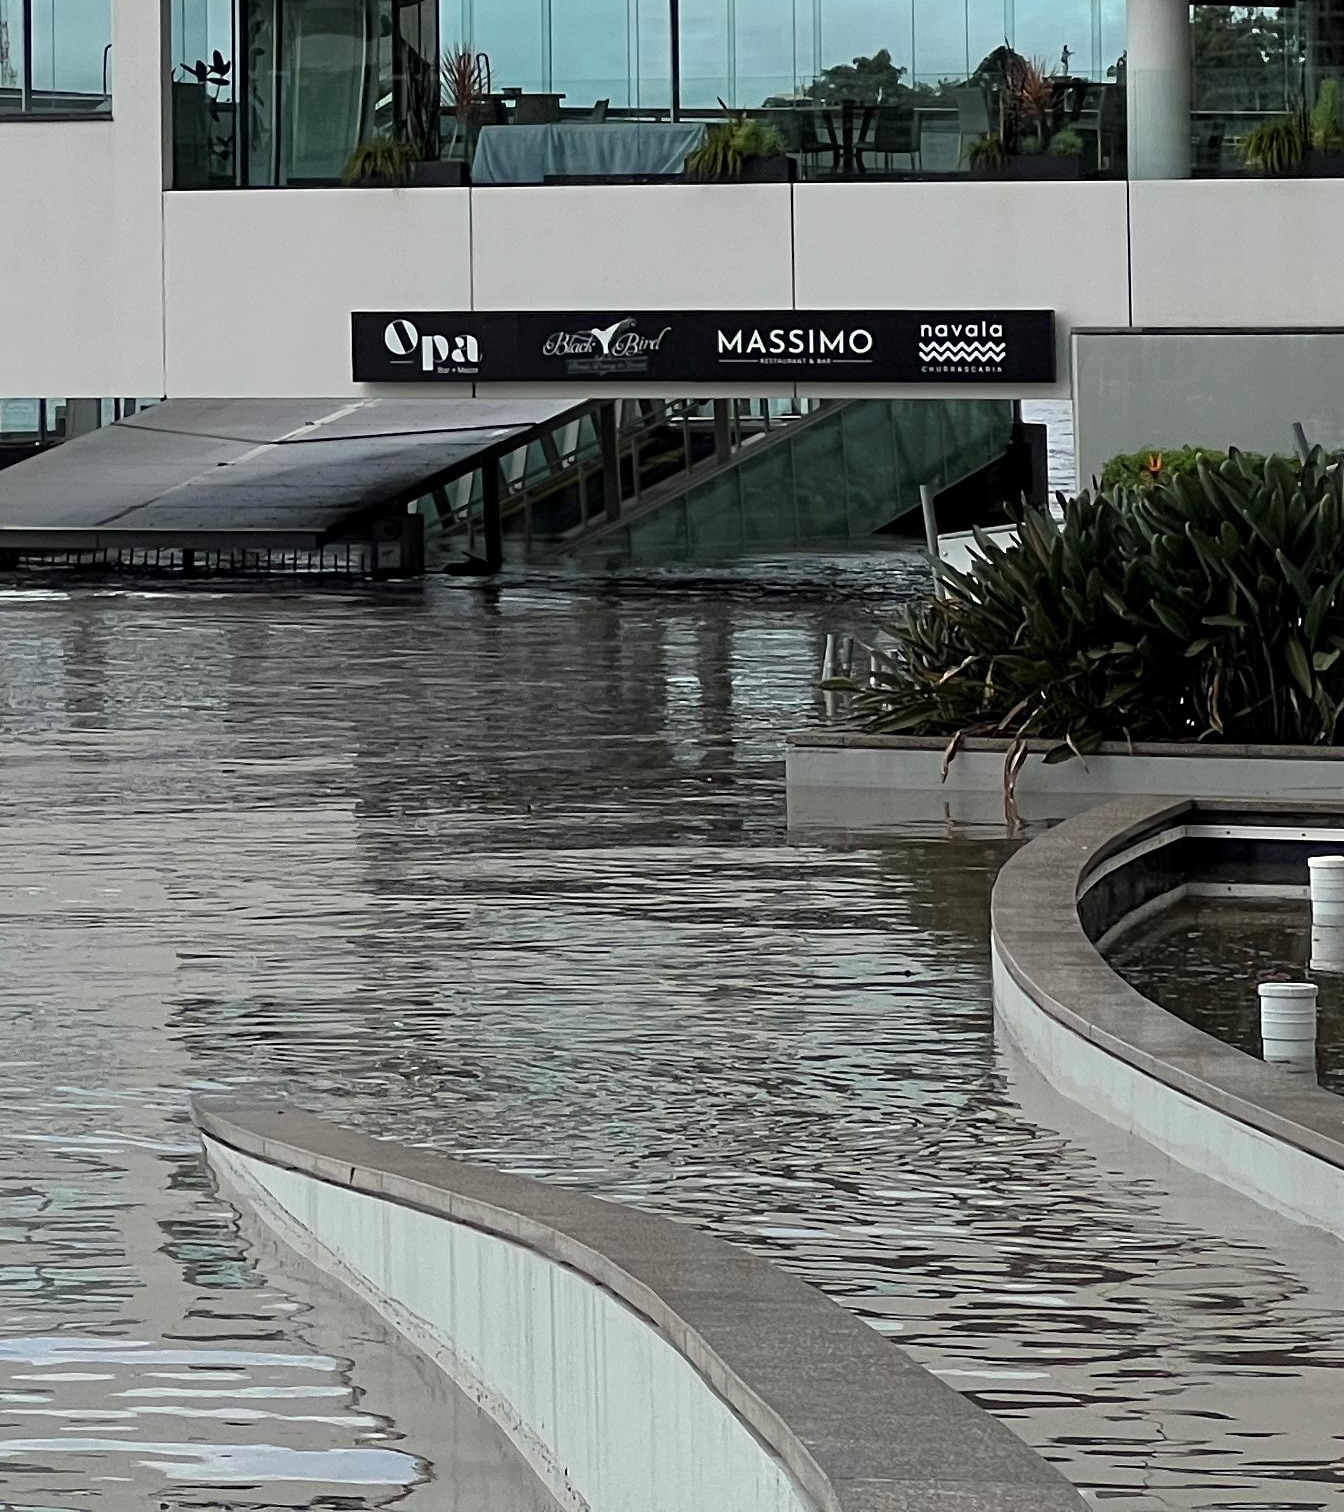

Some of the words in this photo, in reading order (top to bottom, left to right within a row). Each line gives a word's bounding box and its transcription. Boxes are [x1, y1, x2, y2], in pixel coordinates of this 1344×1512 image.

[542, 331, 593, 356] Black
[611, 326, 672, 357] Bird
[717, 329, 873, 354] MASSIMO
[920, 320, 1003, 338] navala
[384, 319, 480, 371] Opa
